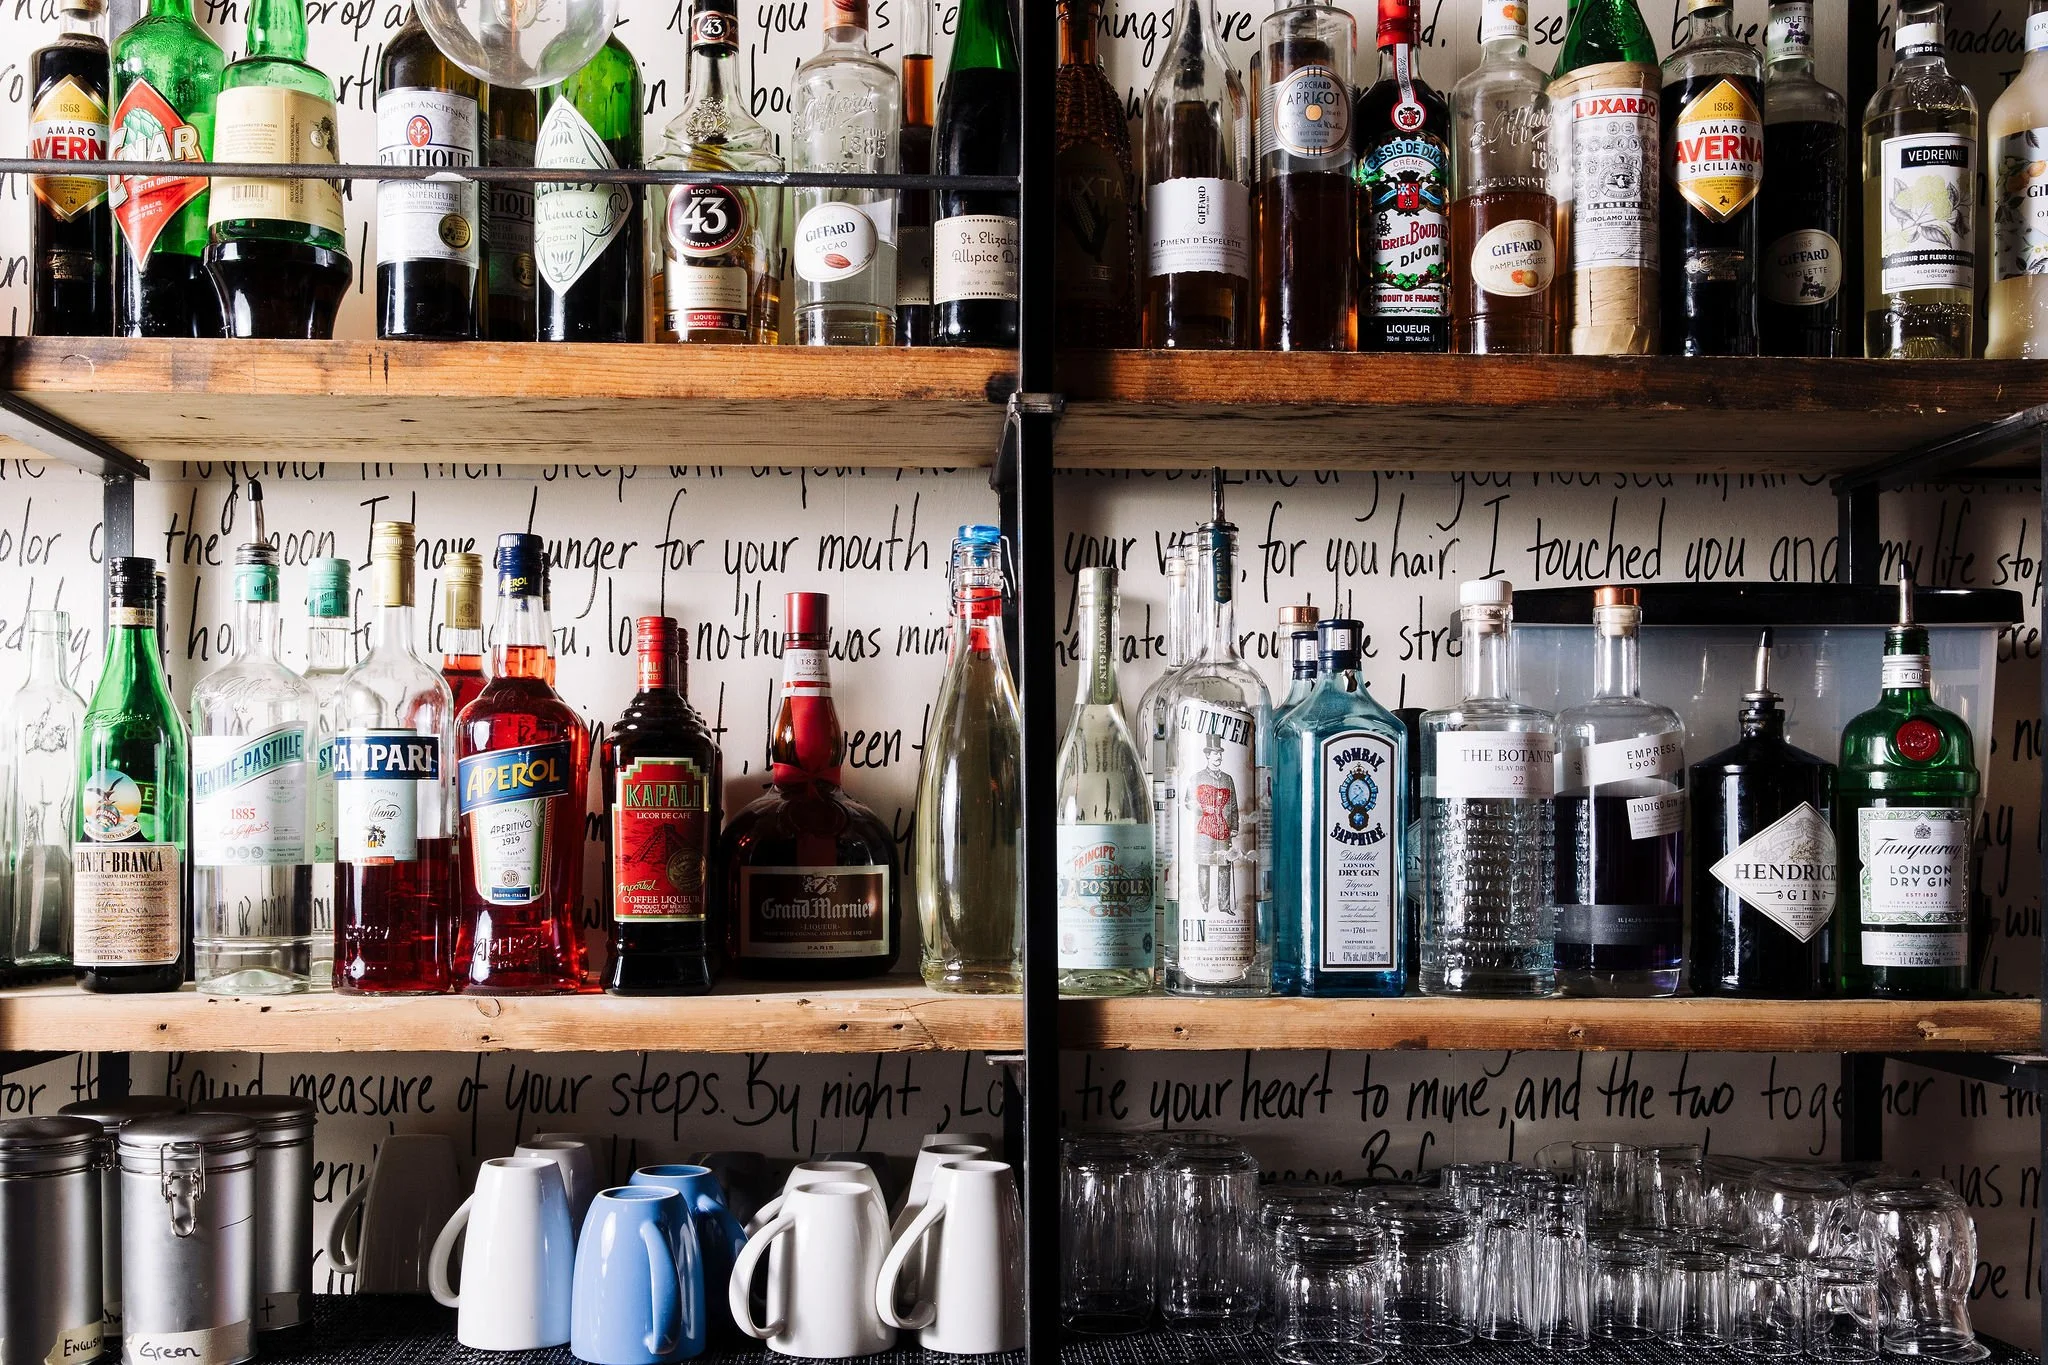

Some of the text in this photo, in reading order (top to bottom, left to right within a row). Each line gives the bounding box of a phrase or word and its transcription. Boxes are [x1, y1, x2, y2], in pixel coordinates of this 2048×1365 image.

[702, 20, 722, 35] 43
[1905, 46, 1924, 55] FLEUR
[1297, 81, 1331, 89] ORCHARD
[1287, 91, 1340, 106] APRICOT
[59, 103, 80, 114] 1868
[419, 101, 470, 124] ANCIENNE
[1575, 98, 1656, 119] LUXARDO
[1714, 102, 1734, 112] 1868
[47, 127, 97, 137] AMARO
[1699, 125, 1747, 135] AMARO
[840, 135, 886, 158] 1885
[1672, 136, 1762, 165] AVERNA
[1366, 144, 1405, 170] CASSIS
[1406, 142, 1419, 155] DE
[1908, 149, 1964, 162] VEDRENNE
[1690, 163, 1754, 173] SICILIANO
[1197, 185, 1207, 225] GIFFARD
[678, 197, 727, 234] 43
[547, 234, 577, 243] DOLIN
[805, 222, 856, 243] GIFFARD
[960, 232, 975, 244] St.
[815, 240, 848, 254] CACAO
[1492, 239, 1543, 256] GIFFARD
[952, 249, 999, 265] Allspice
[1400, 244, 1439, 267] DIJON
[1777, 248, 1830, 266] GIFFARD
[1891, 255, 1918, 264] LIQUEUR
[1929, 253, 1948, 261] FLEUR
[1490, 257, 1548, 271] PAMPLEMOUSSE
[1785, 267, 1828, 279] VIOLETTE
[1404, 294, 1414, 303] DE
[1415, 294, 1440, 303] FRANCE
[1386, 325, 1430, 335] LIQUEUR
[165, 488, 222, 565] the
[358, 495, 390, 571] I
[655, 488, 705, 618] for
[724, 535, 799, 617] your
[819, 493, 929, 572] mouth
[1063, 531, 1137, 636] your
[1258, 500, 1307, 602] for
[1326, 538, 1378, 620] you
[1389, 493, 1458, 580] hair.
[1480, 494, 1511, 580] I
[1527, 496, 1666, 583] touched
[1686, 537, 1746, 584] you
[500, 576, 529, 592] AEROL
[800, 658, 822, 666] 1827
[1098, 655, 1107, 680] GIN
[1180, 704, 1250, 747] CUNTER
[333, 743, 434, 773] CAMPARI
[1332, 746, 1386, 772] BOMBAY
[1462, 749, 1555, 764] THE BOTANIST
[1626, 743, 1677, 760] EMPRESS
[1494, 764, 1513, 772] ISLAY
[1627, 757, 1657, 770] 1908
[466, 759, 560, 802] APEROL
[1512, 775, 1524, 786] 22
[625, 784, 701, 807] KAPALI
[1632, 797, 1679, 812] INDIGO GIN
[231, 807, 257, 820] 1885
[637, 812, 672, 820] LICOR DE
[490, 819, 532, 834] APERITIVO
[502, 836, 521, 846] 1919
[1330, 823, 1387, 847] SAPPHIRE
[1339, 848, 1378, 862] Distilled
[1874, 837, 1961, 860] Tanqueray
[1094, 863, 1125, 876] DE LOS
[1338, 869, 1380, 877] DRY GIN
[1889, 864, 1952, 876] LONDON
[617, 879, 661, 898] Imported
[1345, 878, 1373, 891] Vapour
[1889, 876, 1952, 887] DRY GIN
[623, 895, 702, 905] COFFEE LIQUEUR
[1787, 889, 1821, 901] GIN
[761, 896, 874, 920] Grand Marnier
[1183, 918, 1206, 942] GIN
[1352, 926, 1366, 934] 1761
[1150, 1078, 1234, 1130] your
[1240, 1050, 1333, 1122] heart
[1352, 1054, 1389, 1122] to
[1514, 1051, 1583, 1122] and
[1597, 1051, 1656, 1120] the
[1669, 1052, 1736, 1119] two
[289, 1069, 436, 1117] measure
[458, 1052, 490, 1157] of
[505, 1064, 593, 1140] your
[608, 1053, 725, 1141] steps.
[733, 1053, 801, 1152] By
[822, 1053, 920, 1163] night
[140, 1341, 202, 1361] Green
